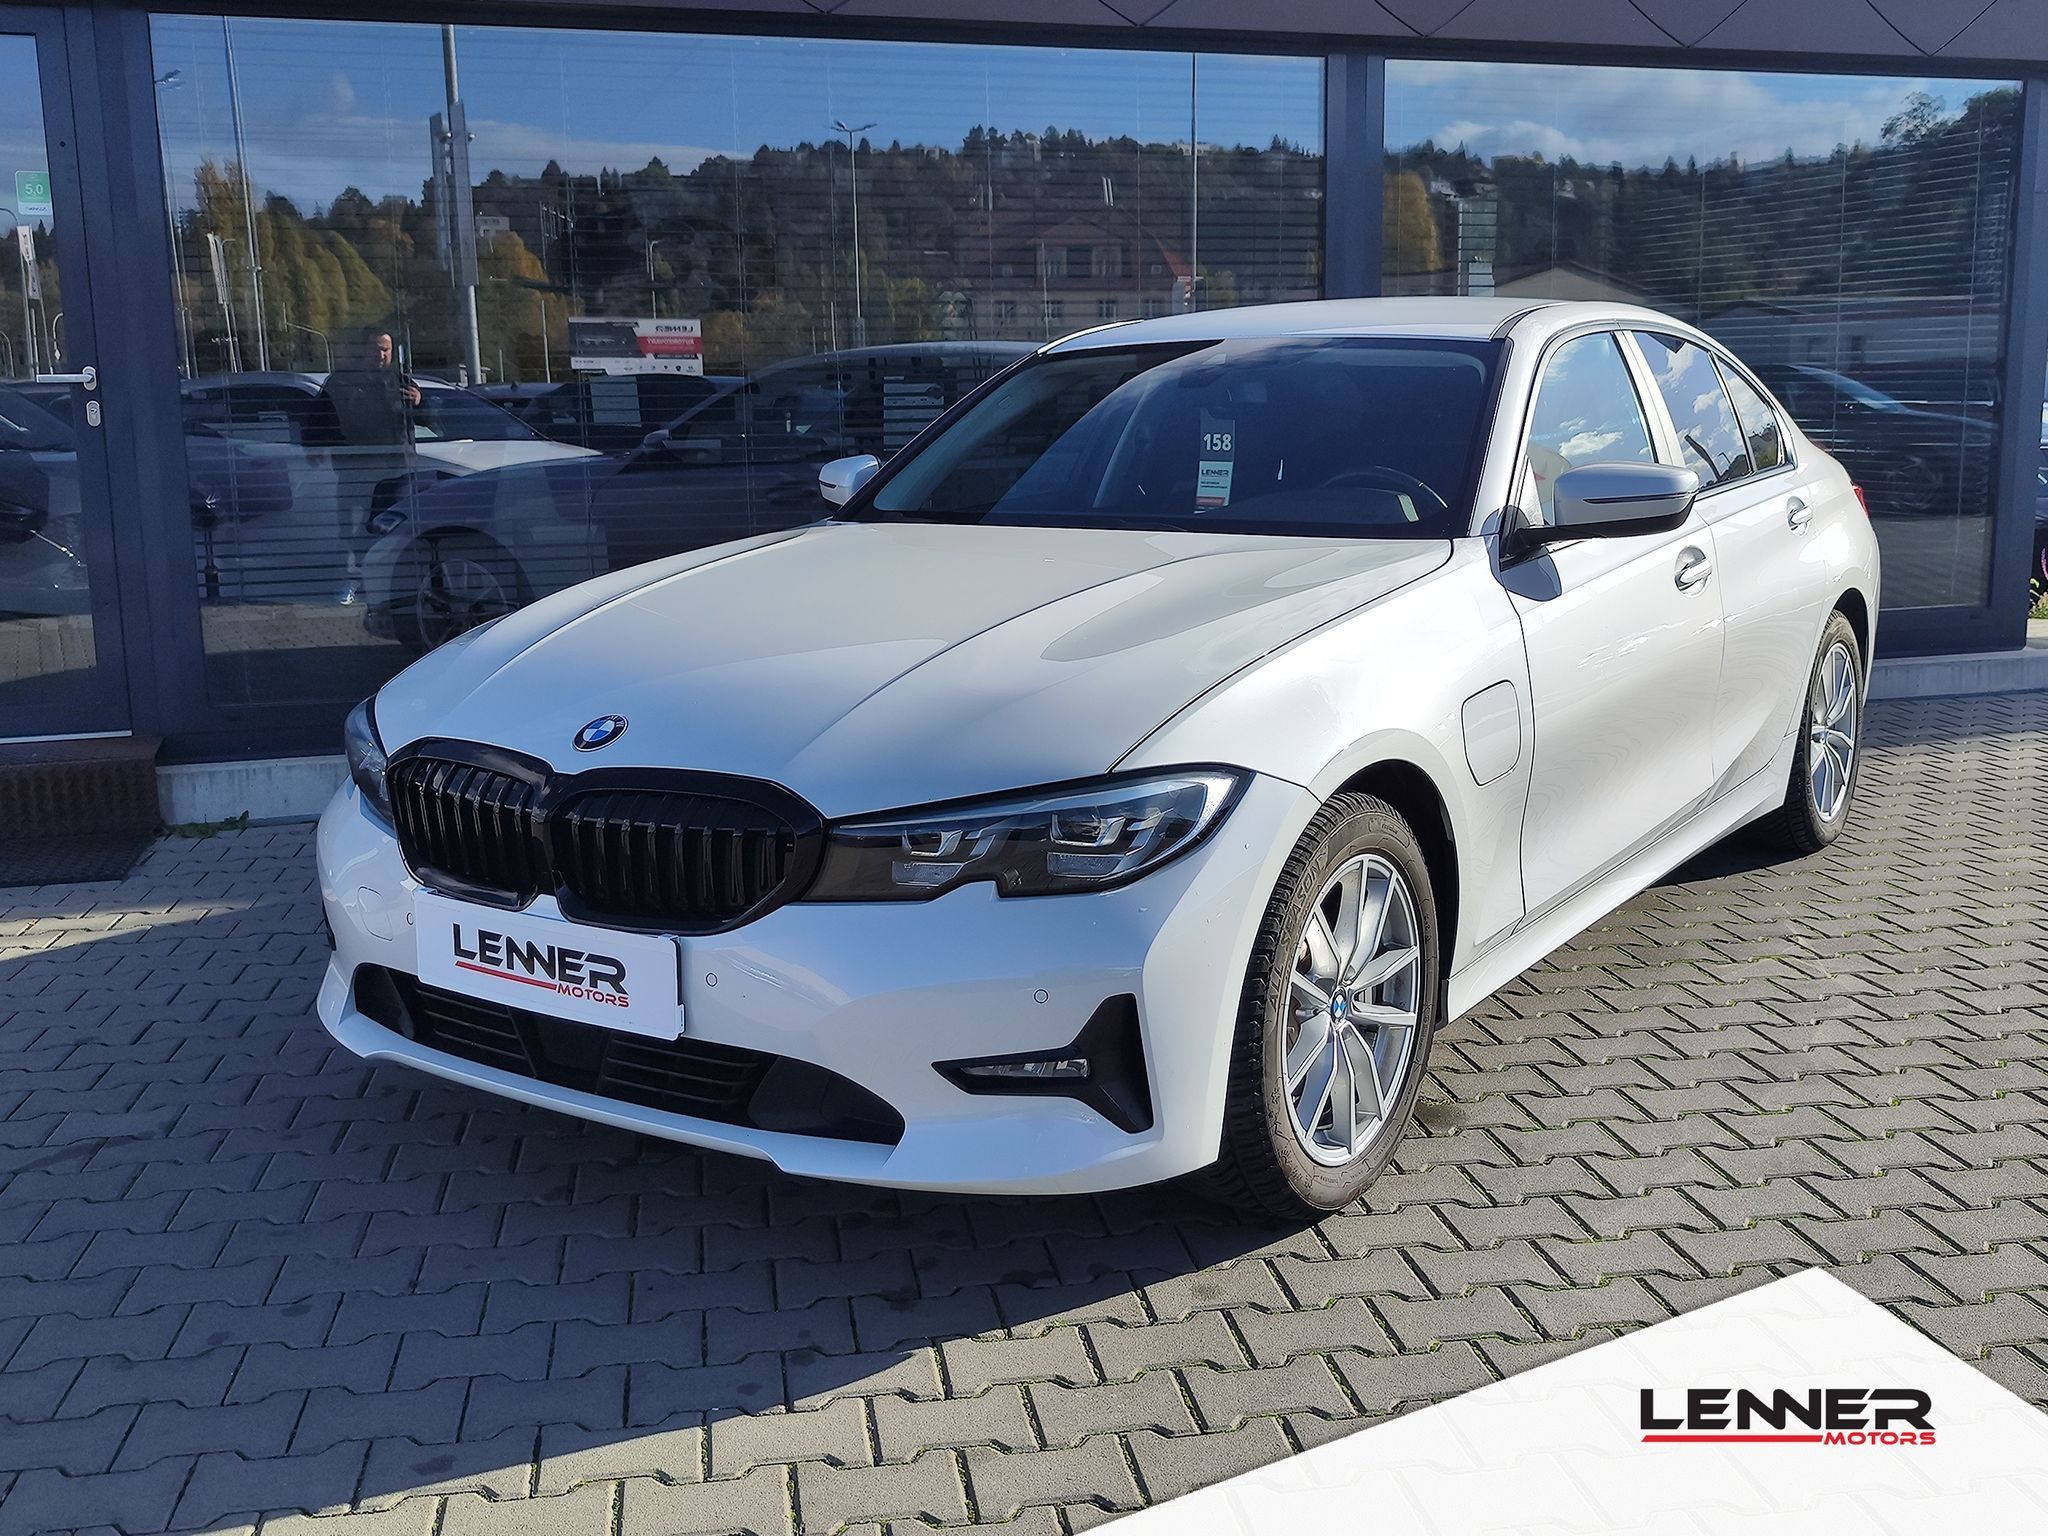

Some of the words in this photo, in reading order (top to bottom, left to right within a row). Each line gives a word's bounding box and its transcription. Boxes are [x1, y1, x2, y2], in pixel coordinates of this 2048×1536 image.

[1203, 434, 1232, 451] 158
[453, 923, 628, 994] LENNER
[557, 983, 629, 1008] MOTORS
